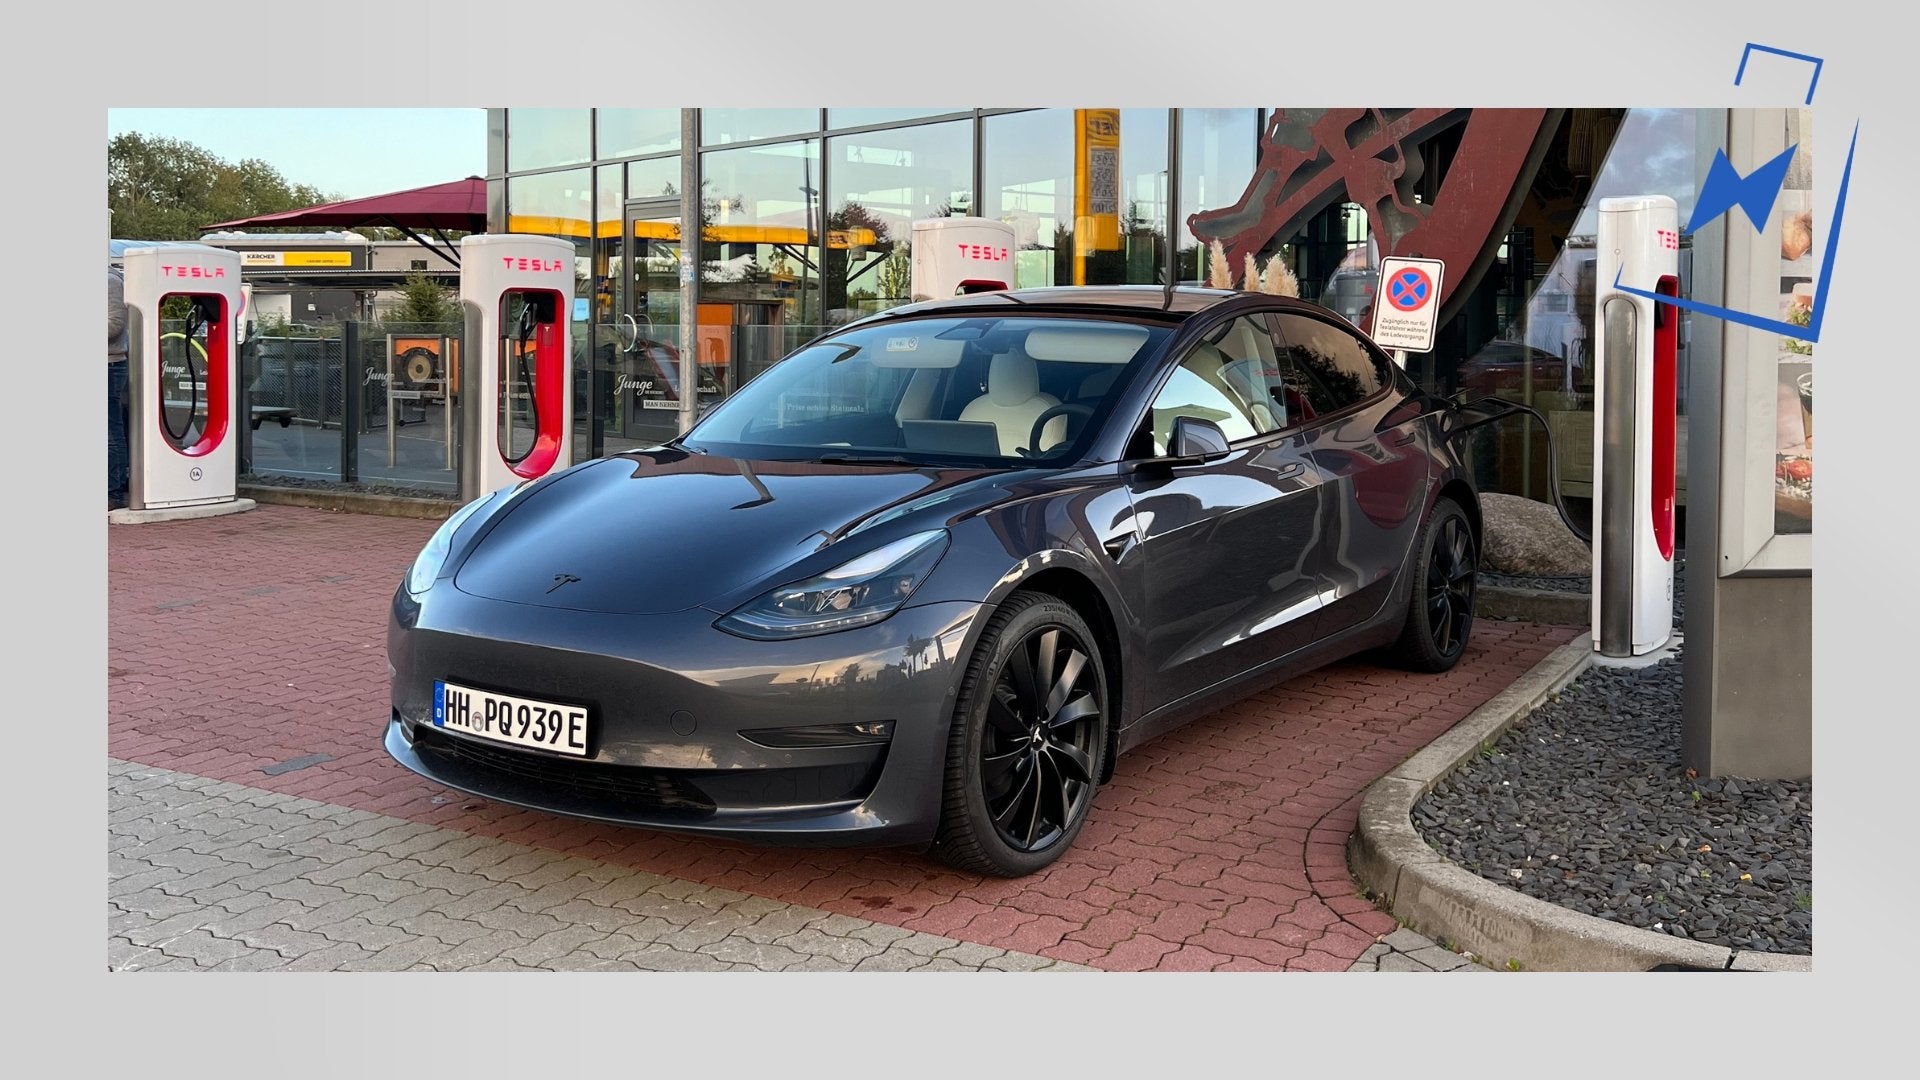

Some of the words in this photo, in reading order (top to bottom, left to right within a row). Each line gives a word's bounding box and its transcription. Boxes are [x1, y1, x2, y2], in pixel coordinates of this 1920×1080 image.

[1657, 230, 1678, 250] TES
[958, 244, 1008, 262] TESLA
[162, 266, 225, 278] TESLA
[502, 257, 562, 272] TESLA
[161, 360, 186, 378] Junge
[363, 367, 395, 386] Junge
[613, 374, 652, 396] Junge
[445, 689, 470, 727] HH
[485, 698, 511, 736] PQ
